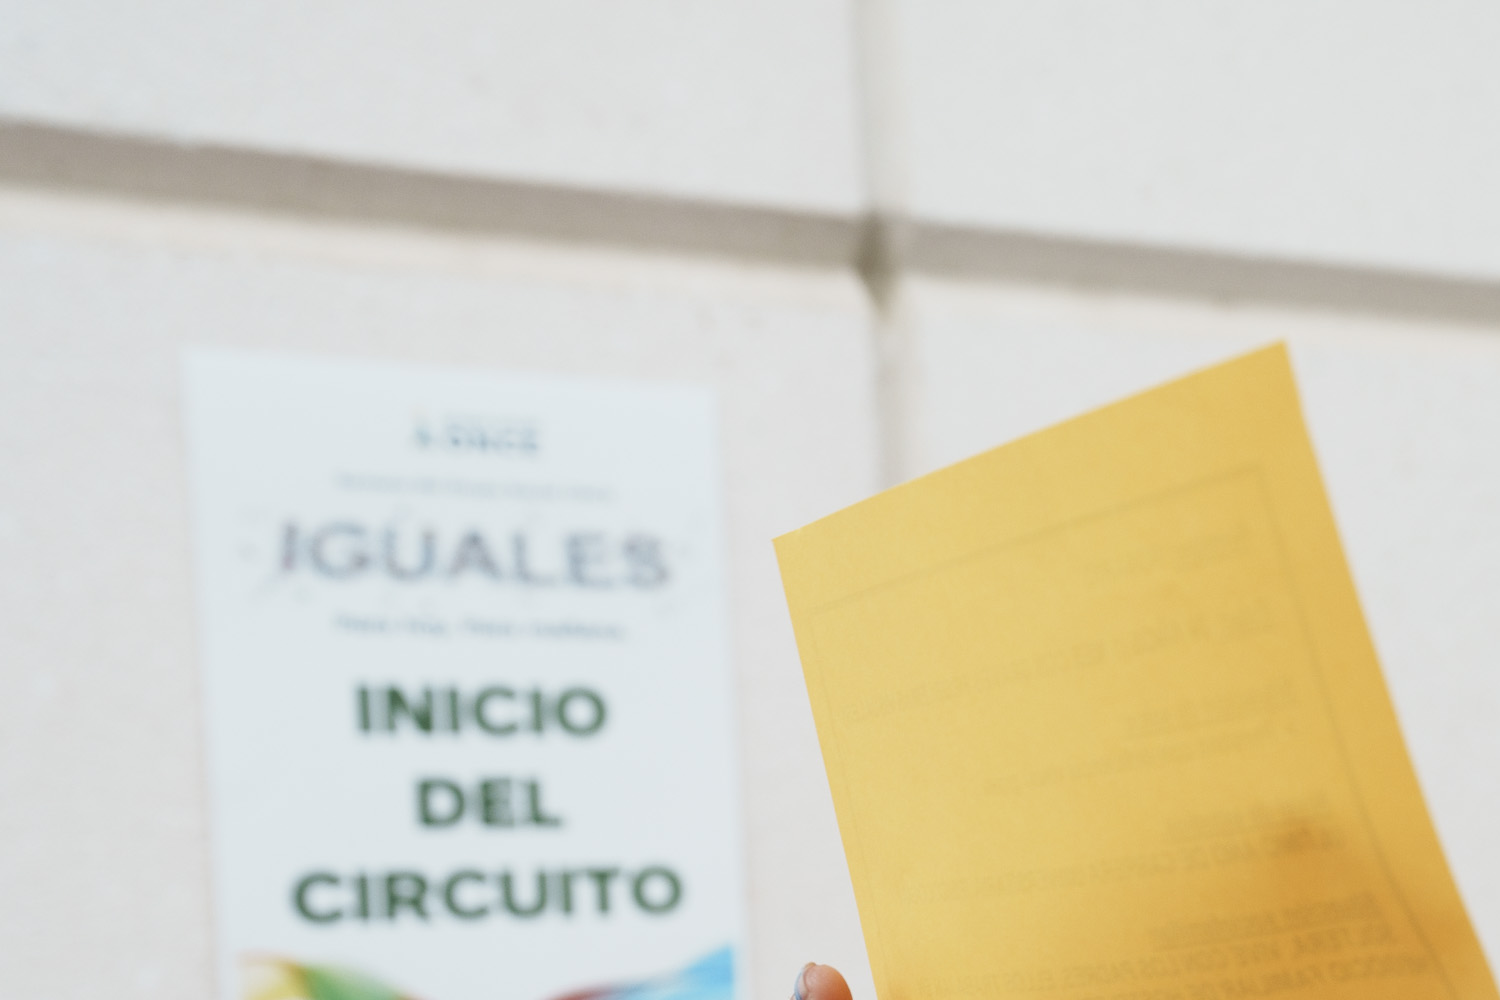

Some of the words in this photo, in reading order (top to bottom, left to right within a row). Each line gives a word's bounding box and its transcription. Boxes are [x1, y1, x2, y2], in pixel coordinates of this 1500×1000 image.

[277, 518, 673, 590] IGUALES
[356, 683, 609, 737] INICIO
[415, 778, 561, 829] DEL
[292, 866, 685, 923] CIRCUITO
